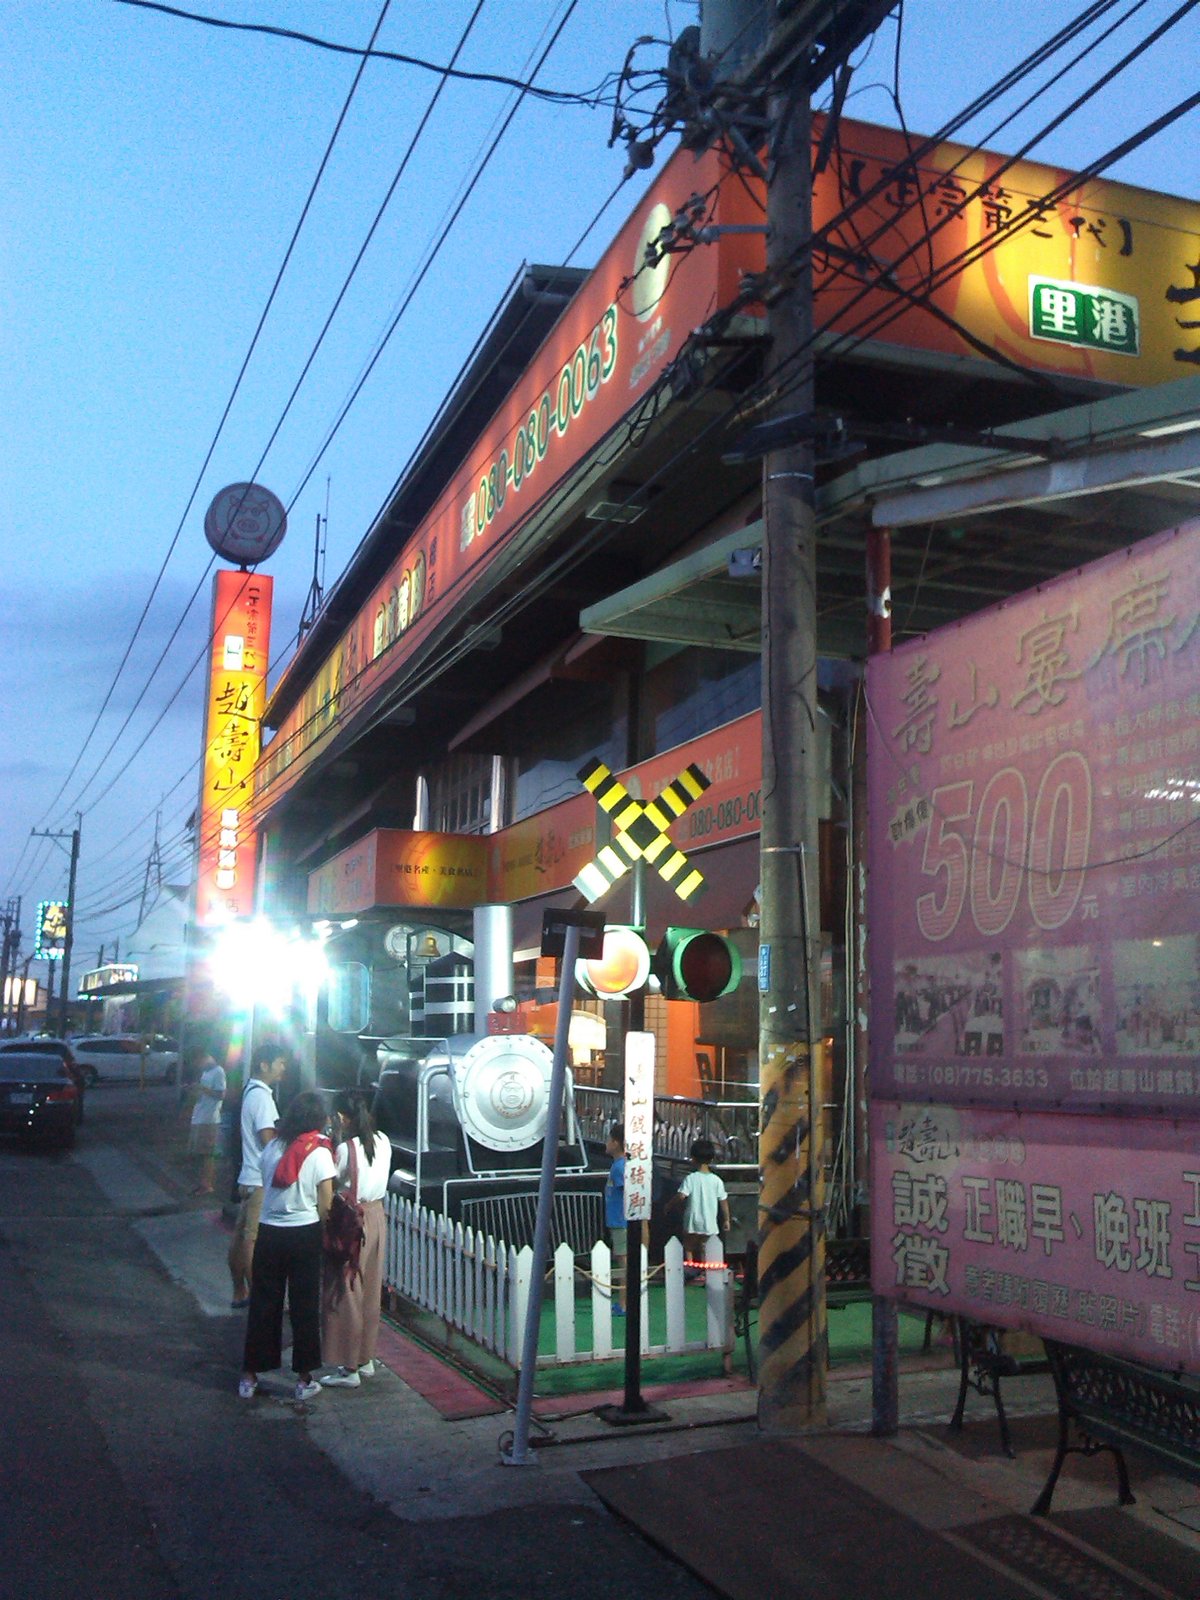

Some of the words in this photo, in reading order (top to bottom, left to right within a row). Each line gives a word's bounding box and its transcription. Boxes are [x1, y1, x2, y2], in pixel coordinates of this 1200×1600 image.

[1036, 284, 1132, 348] 里港
[475, 303, 618, 536] 080-080-0063
[916, 751, 1092, 941] 500
[892, 1171, 951, 1296] 誠徵
